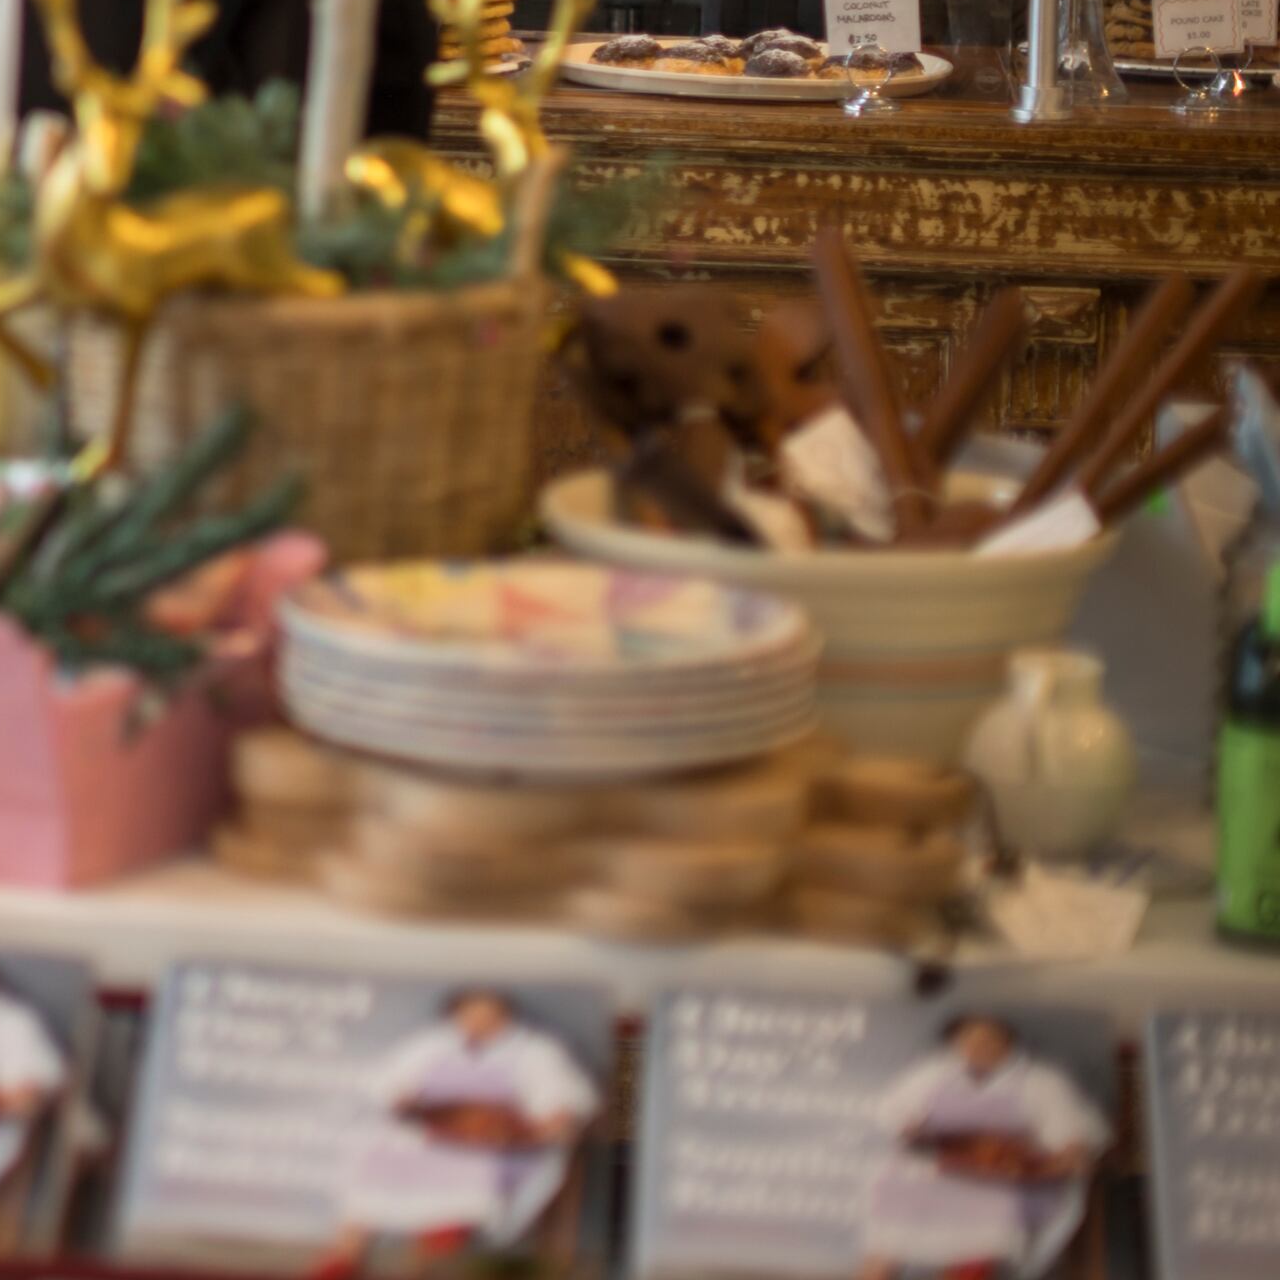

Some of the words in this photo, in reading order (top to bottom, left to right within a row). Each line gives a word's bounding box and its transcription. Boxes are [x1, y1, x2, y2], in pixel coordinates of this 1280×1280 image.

[842, 0, 891, 11] COCONUT
[836, 12, 896, 24] MACAROONS
[1170, 16, 1200, 25] POUND
[1202, 14, 1225, 24] CAKE
